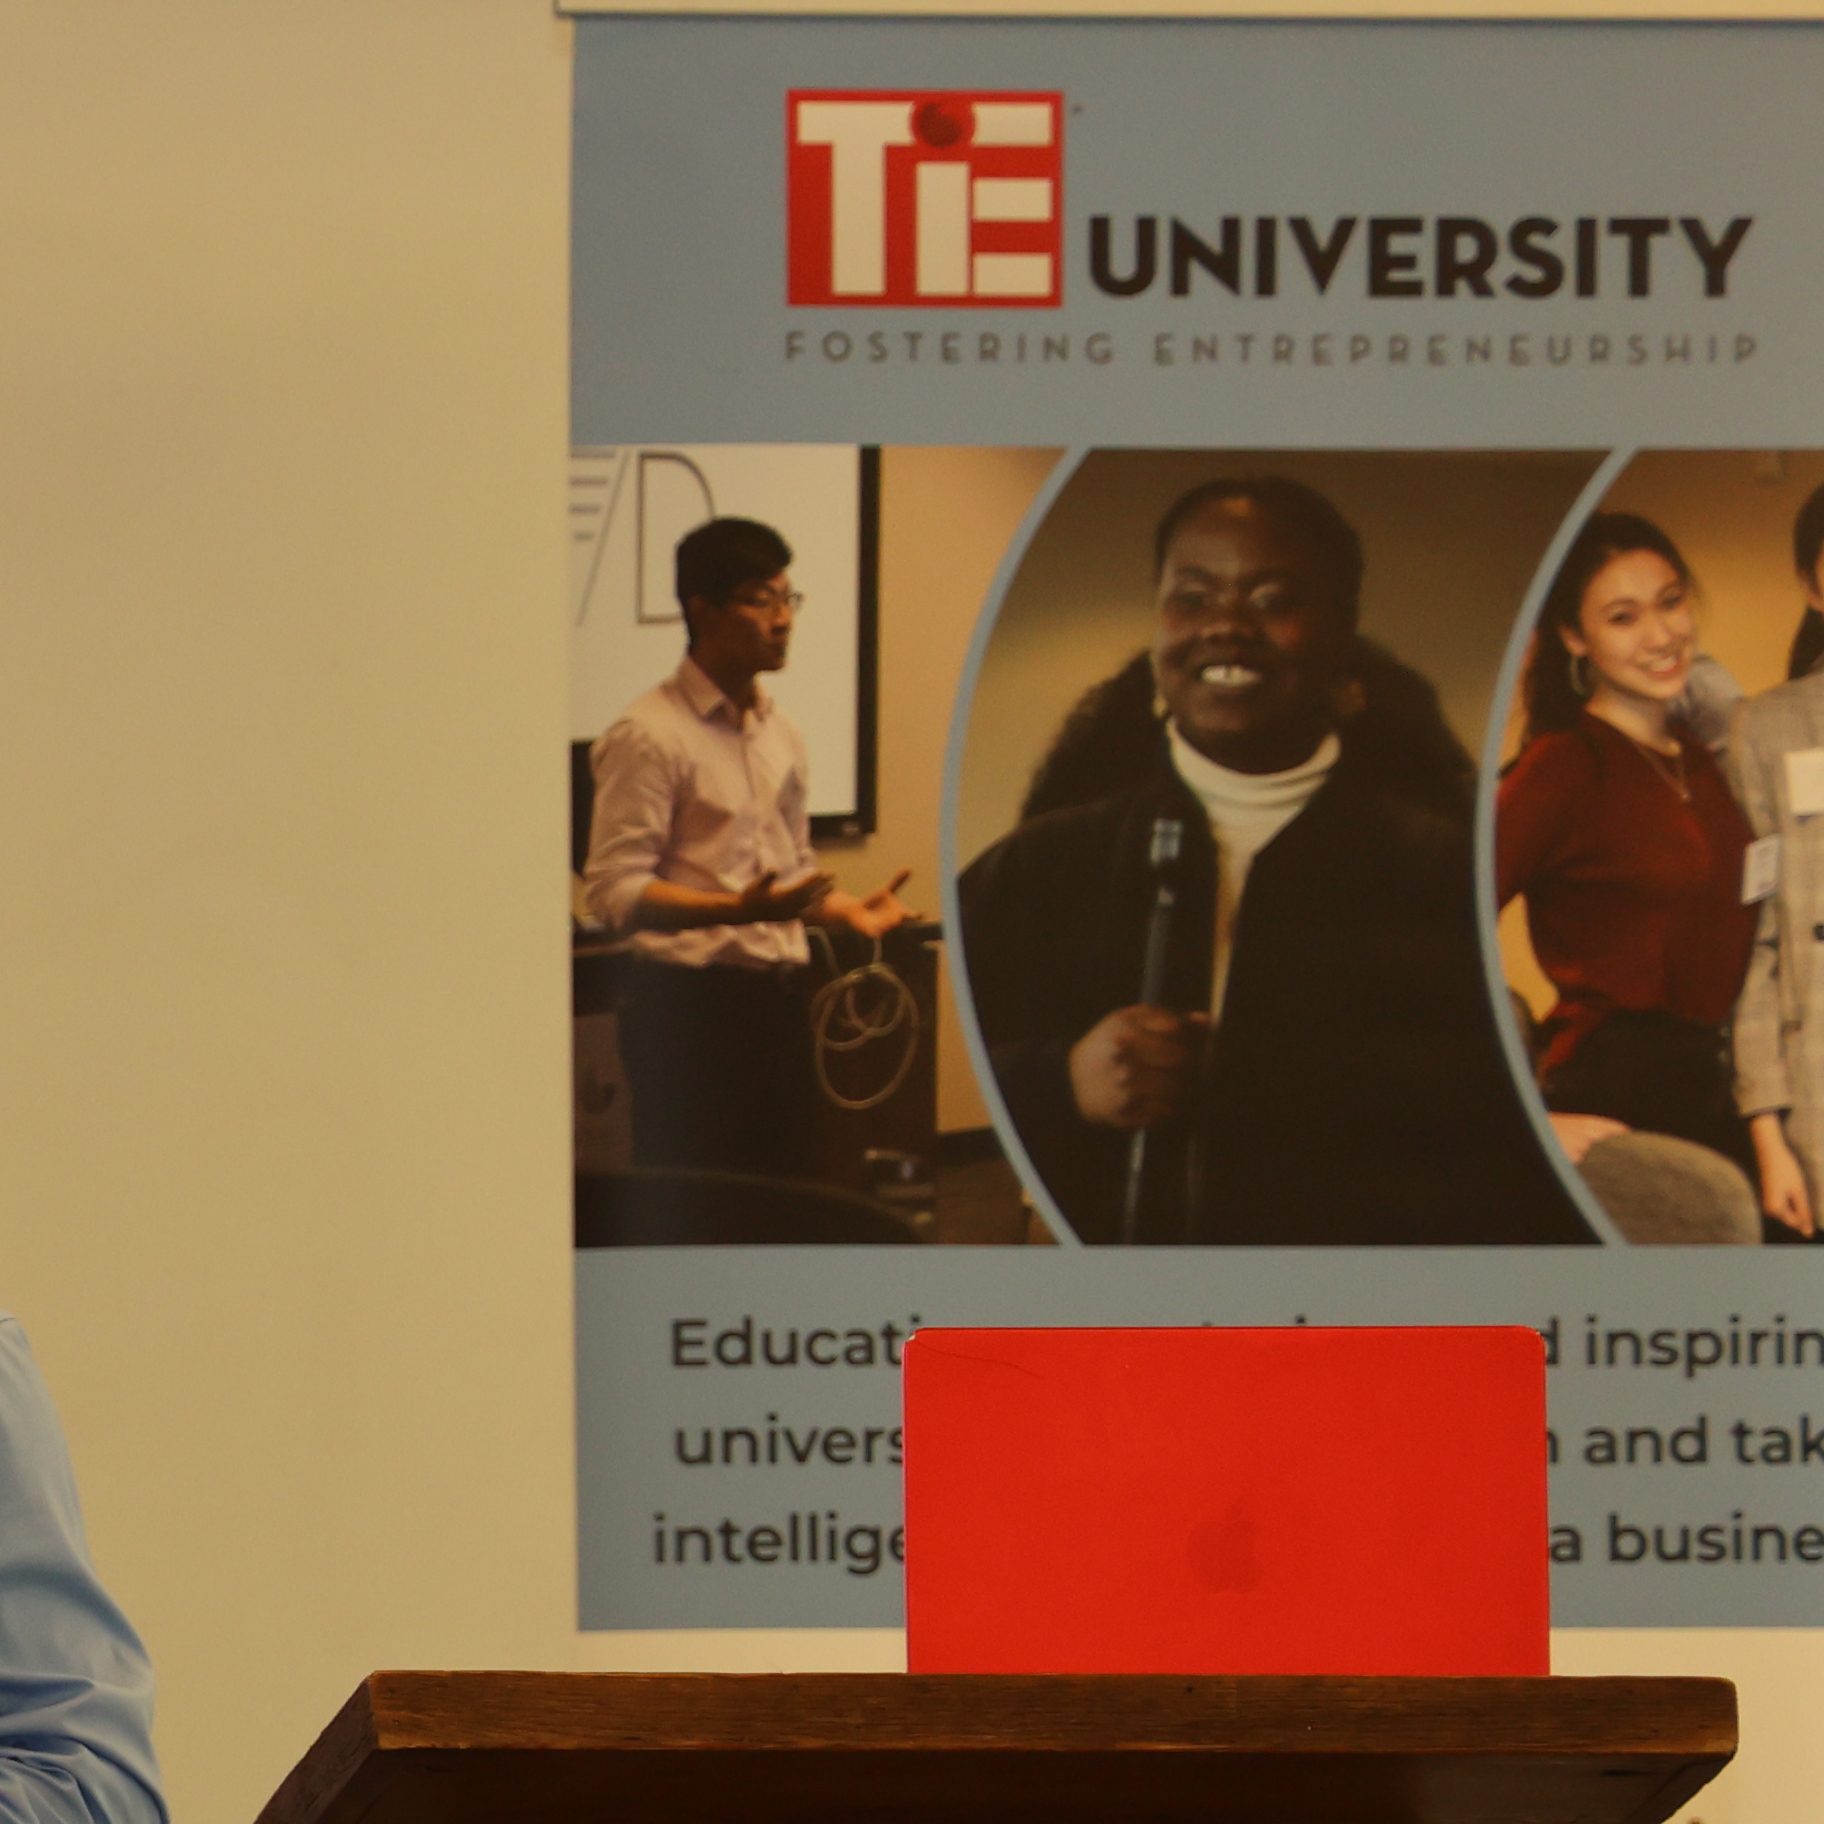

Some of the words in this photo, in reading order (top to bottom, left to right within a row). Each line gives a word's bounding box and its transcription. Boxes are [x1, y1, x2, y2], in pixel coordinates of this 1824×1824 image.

[1088, 215, 1754, 299] UNIVERSITY
[785, 330, 1115, 366] FOSTERING
[1155, 333, 1758, 368] ENTREPRENEURSHIP
[671, 1314, 923, 1368] Educat
[1585, 1314, 1824, 1378] inspirin
[1584, 1415, 1707, 1465] and
[654, 1511, 906, 1576] intellige
[1608, 1511, 1824, 1563] busine
